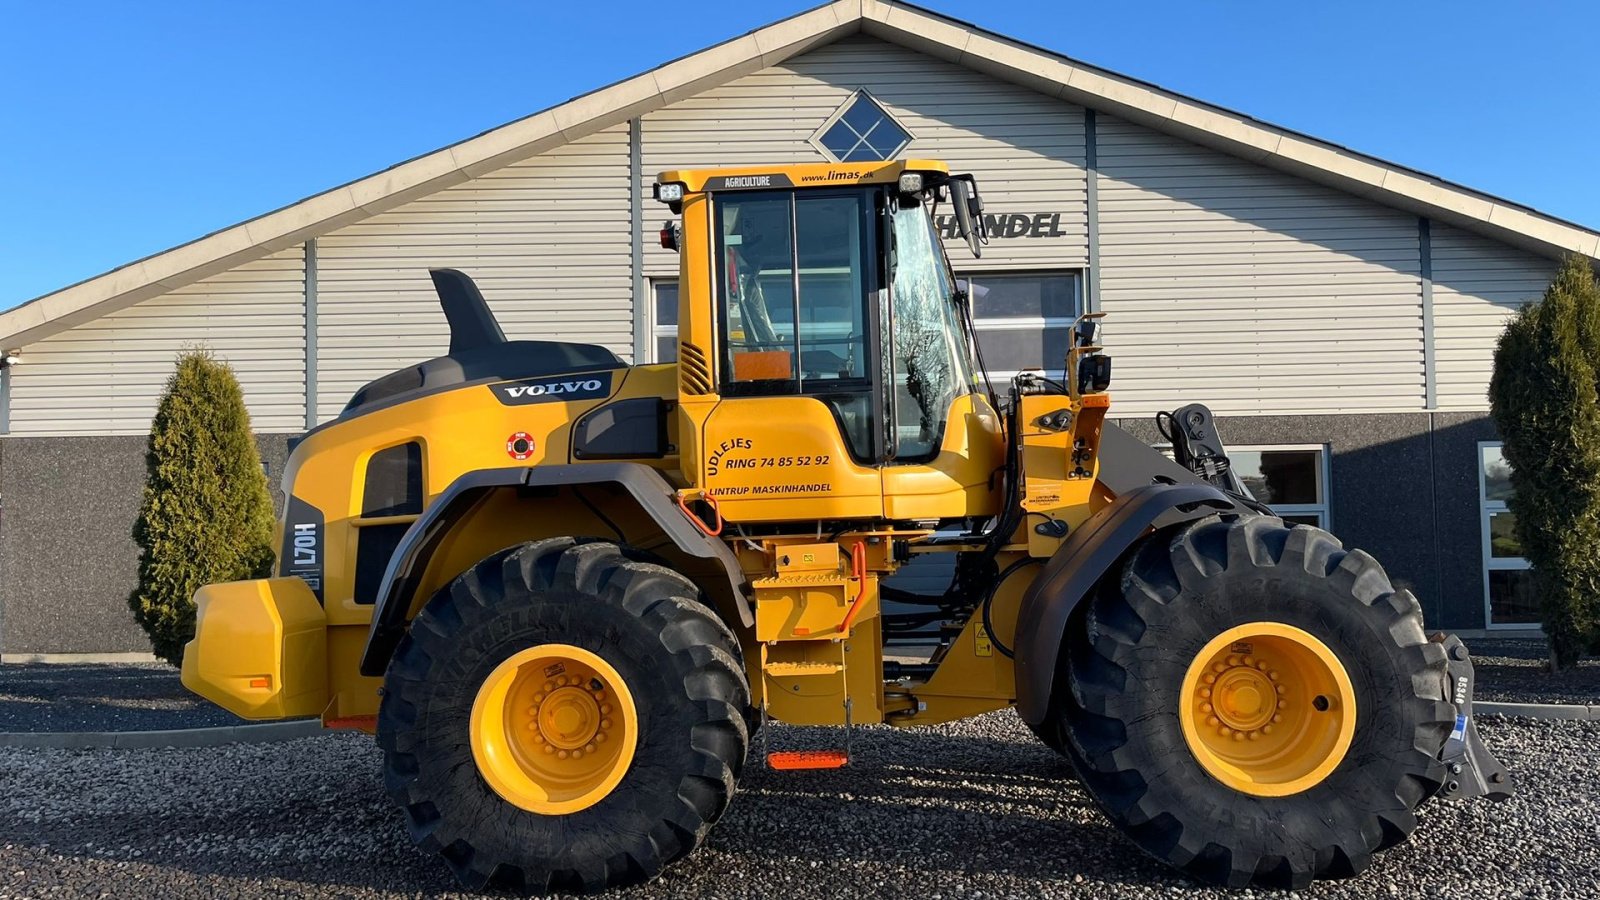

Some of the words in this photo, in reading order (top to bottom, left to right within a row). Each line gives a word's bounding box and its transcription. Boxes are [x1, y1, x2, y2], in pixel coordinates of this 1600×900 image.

[724, 175, 771, 188] AGRICULTURE
[801, 170, 874, 182] www.limas.dk
[936, 213, 1067, 239] HNDEL
[505, 380, 601, 398] VOLVO
[707, 438, 753, 476] UDLEJES
[725, 458, 757, 469] RING
[759, 457, 775, 468] 74
[777, 457, 793, 467] 85
[796, 456, 812, 467] 52
[814, 455, 830, 465] 92
[709, 486, 750, 496] LINTRUP
[752, 483, 832, 494] MASKINHANDEL
[294, 523, 316, 565] L70H
